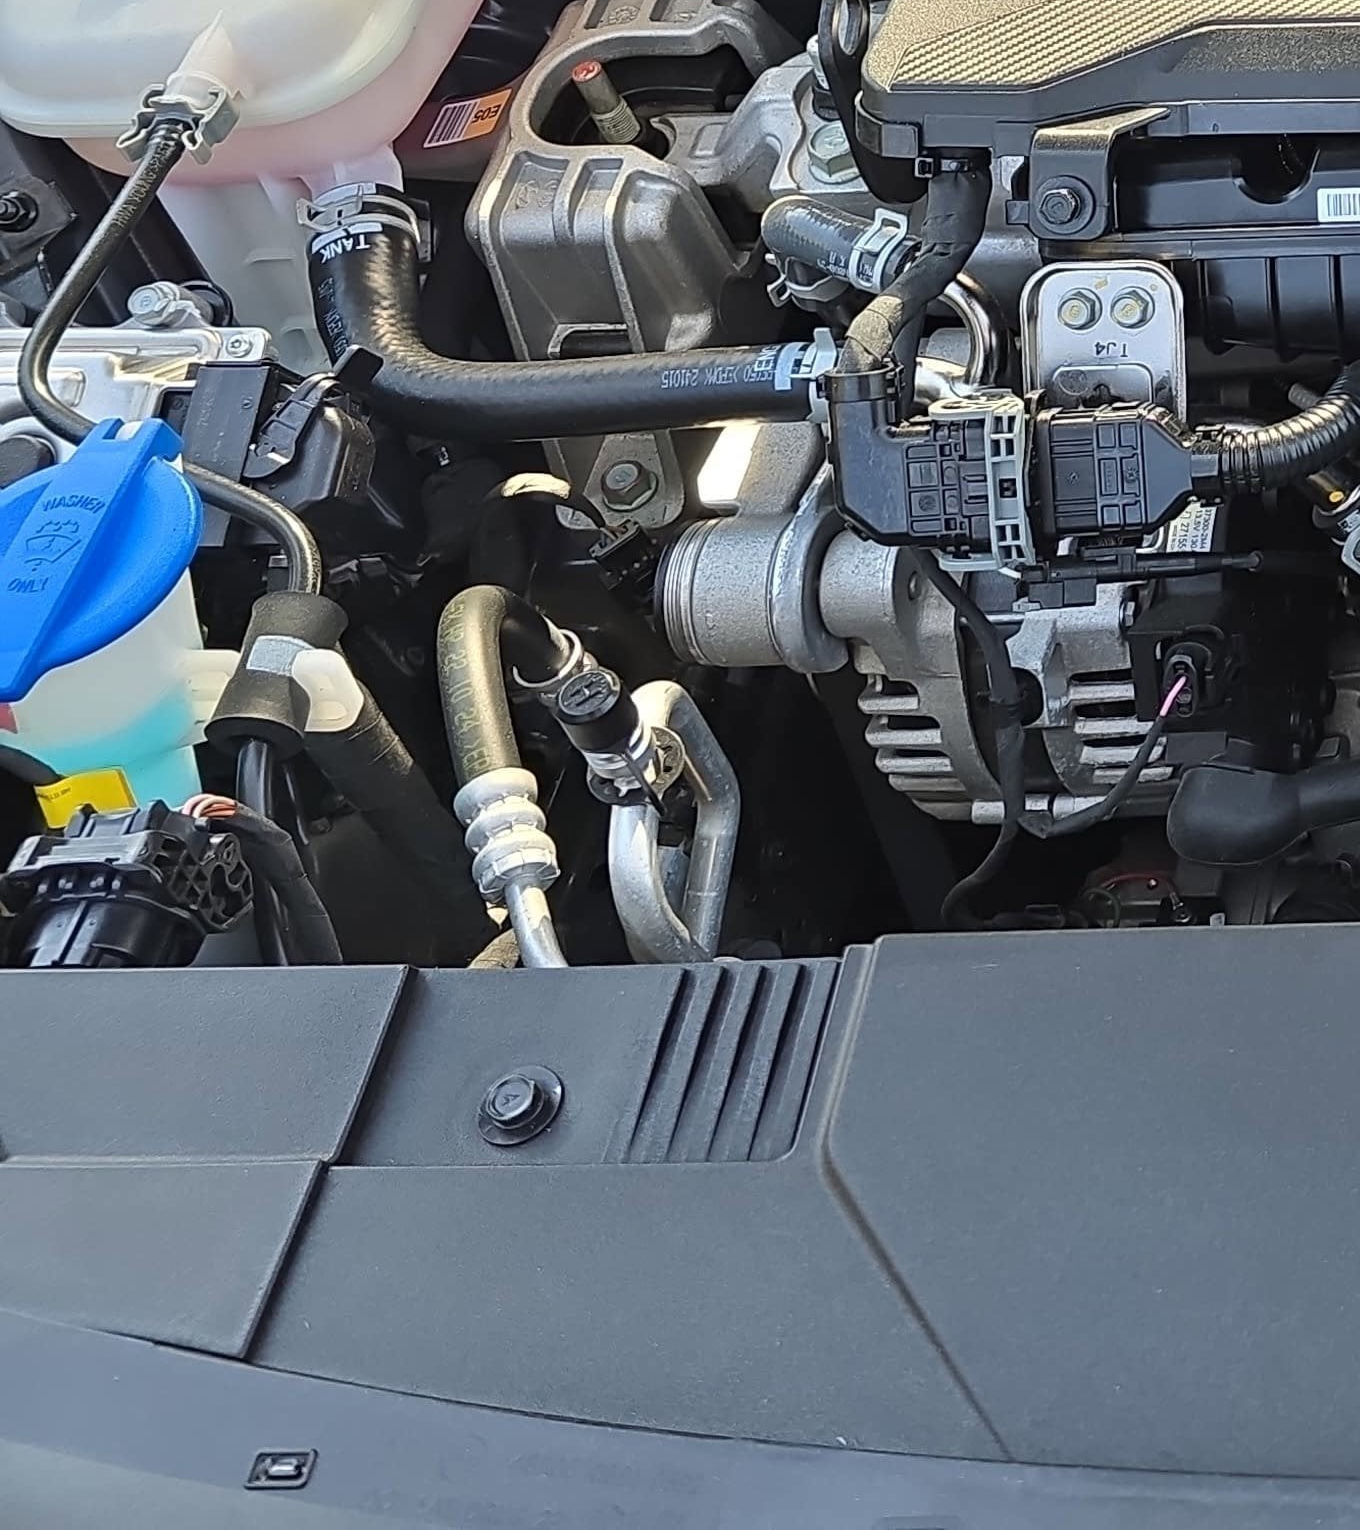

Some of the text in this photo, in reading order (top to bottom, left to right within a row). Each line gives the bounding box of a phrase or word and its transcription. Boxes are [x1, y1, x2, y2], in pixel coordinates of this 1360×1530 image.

[472, 103, 502, 123] E05
[319, 234, 371, 264] TANK
[42, 494, 106, 515] WASHER
[8, 577, 49, 593] ONLY
